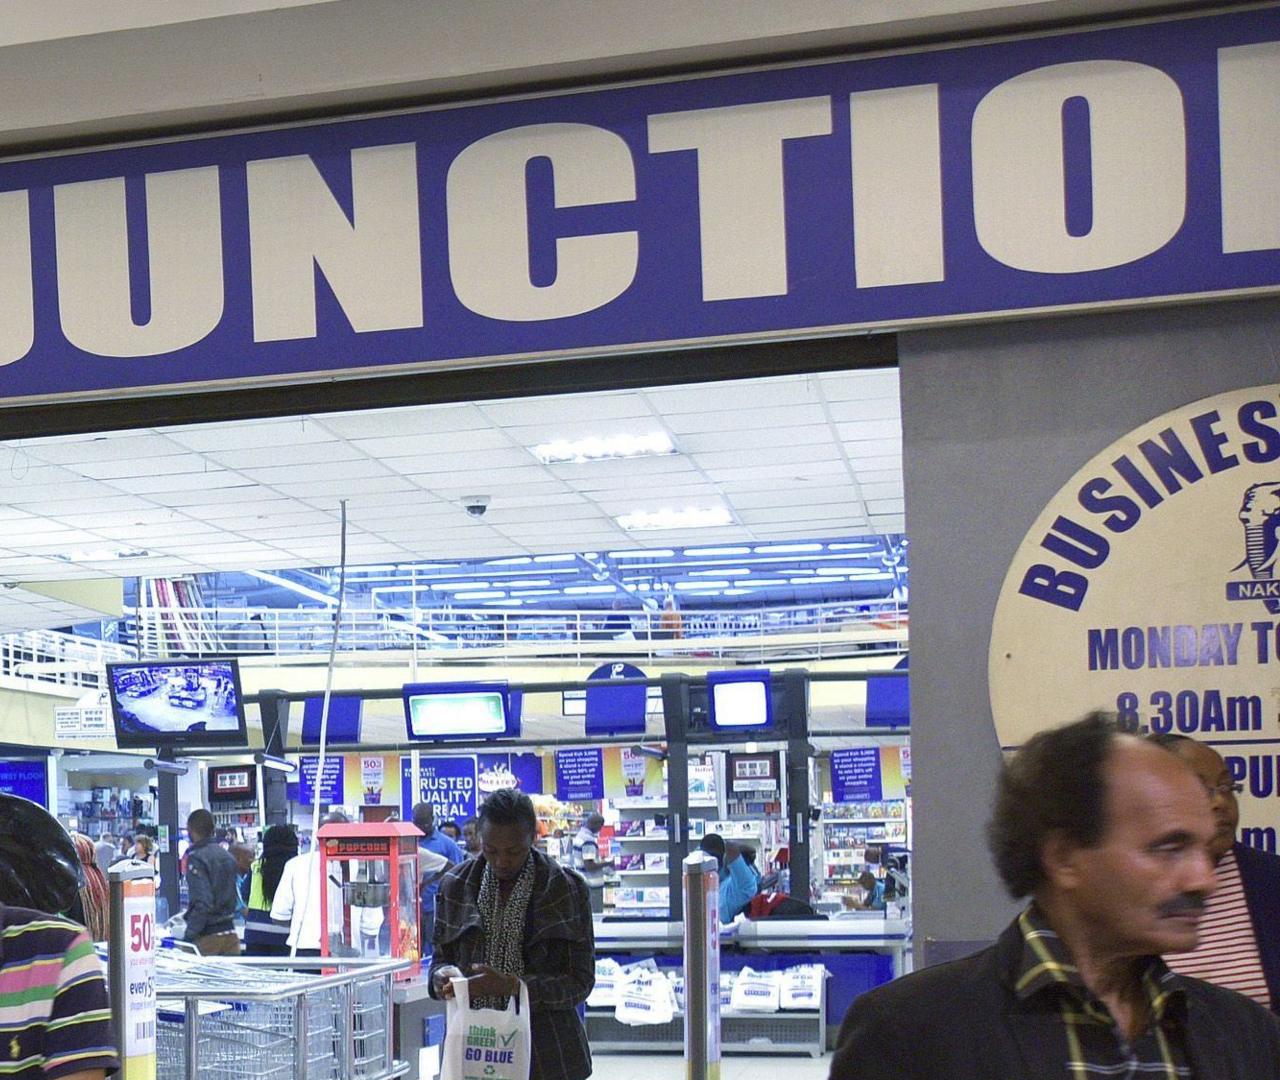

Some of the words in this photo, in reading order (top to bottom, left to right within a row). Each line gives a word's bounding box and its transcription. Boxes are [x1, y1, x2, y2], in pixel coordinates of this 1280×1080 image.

[1088, 623, 1244, 671] MONDAY
[1116, 690, 1262, 735] 8.30Am
[420, 777, 473, 789] RUSTED
[1224, 754, 1280, 799] PU
[421, 791, 472, 803] UALITY
[469, 1025, 496, 1037] think
[467, 1035, 496, 1048] GREEN
[465, 1048, 482, 1061] GO
[485, 1050, 514, 1064] BLUE
